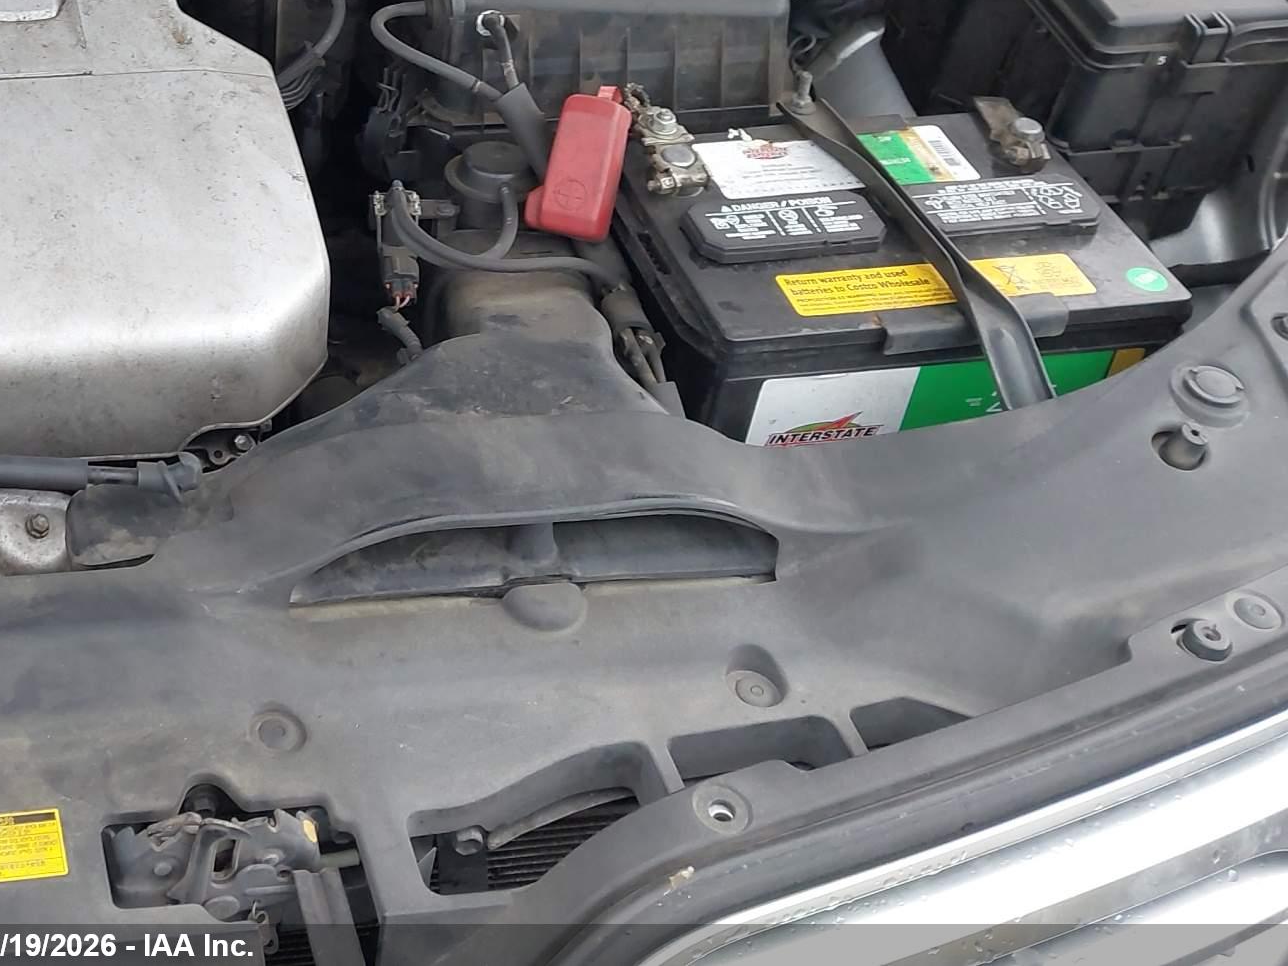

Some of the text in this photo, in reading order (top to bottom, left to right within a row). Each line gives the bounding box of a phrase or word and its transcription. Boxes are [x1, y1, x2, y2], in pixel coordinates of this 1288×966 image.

[731, 201, 780, 212] DANGER
[787, 196, 833, 207] POISON
[784, 268, 908, 286] Return warranty and used
[791, 284, 834, 296] batteries
[845, 281, 879, 291] Costco
[878, 277, 931, 289] Wholesale
[769, 427, 876, 444] INTERSTATE
